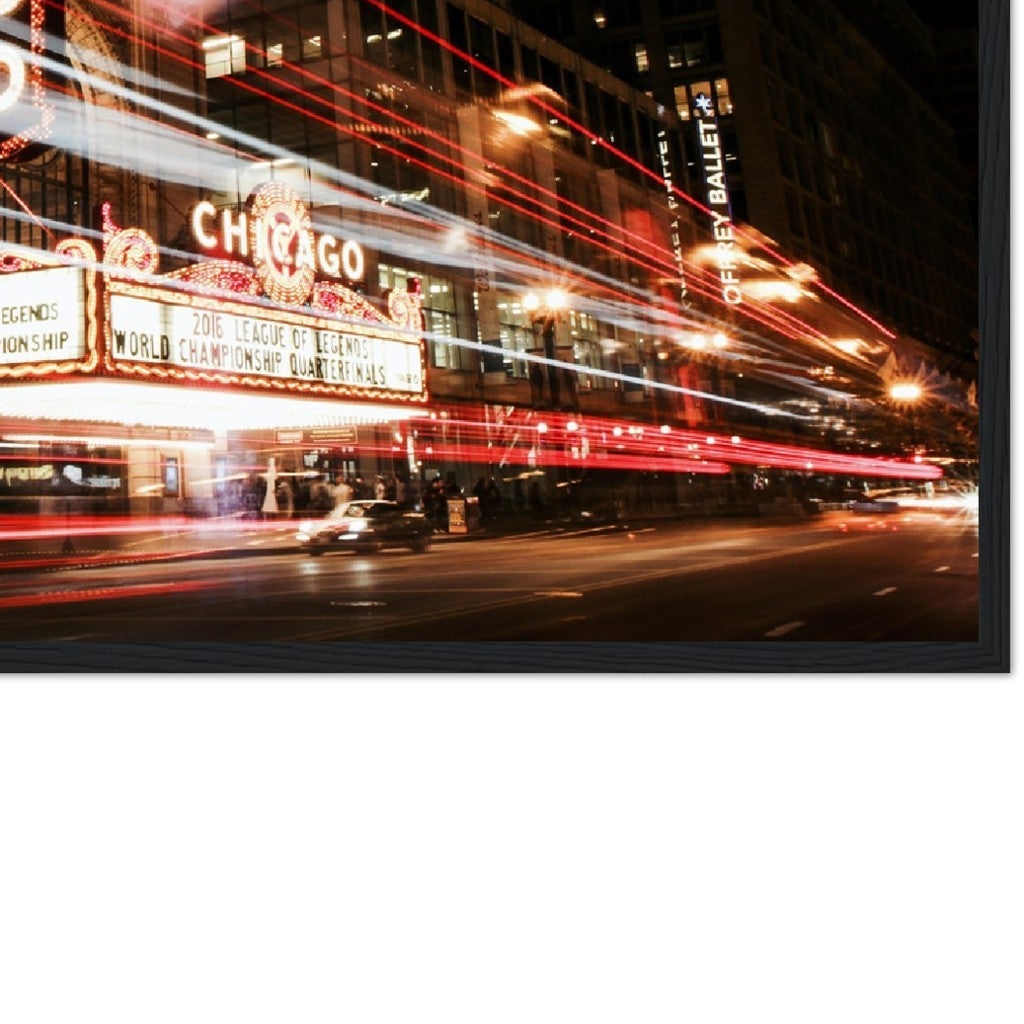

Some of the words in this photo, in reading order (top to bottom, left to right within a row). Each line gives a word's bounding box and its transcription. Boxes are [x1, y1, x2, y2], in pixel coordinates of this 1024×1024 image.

[698, 119, 728, 205] BALLET
[191, 201, 365, 281] CHICAGO
[712, 210, 742, 305] OFFREY
[114, 329, 170, 361] WORLD
[179, 338, 283, 374] CHAMPIONSHIP
[289, 352, 386, 385] QUARTERFINALS
[192, 312, 225, 339] 2016
[234, 319, 286, 349] LEAGUE
[292, 329, 308, 350] OF
[315, 331, 369, 360] LEGENDS
